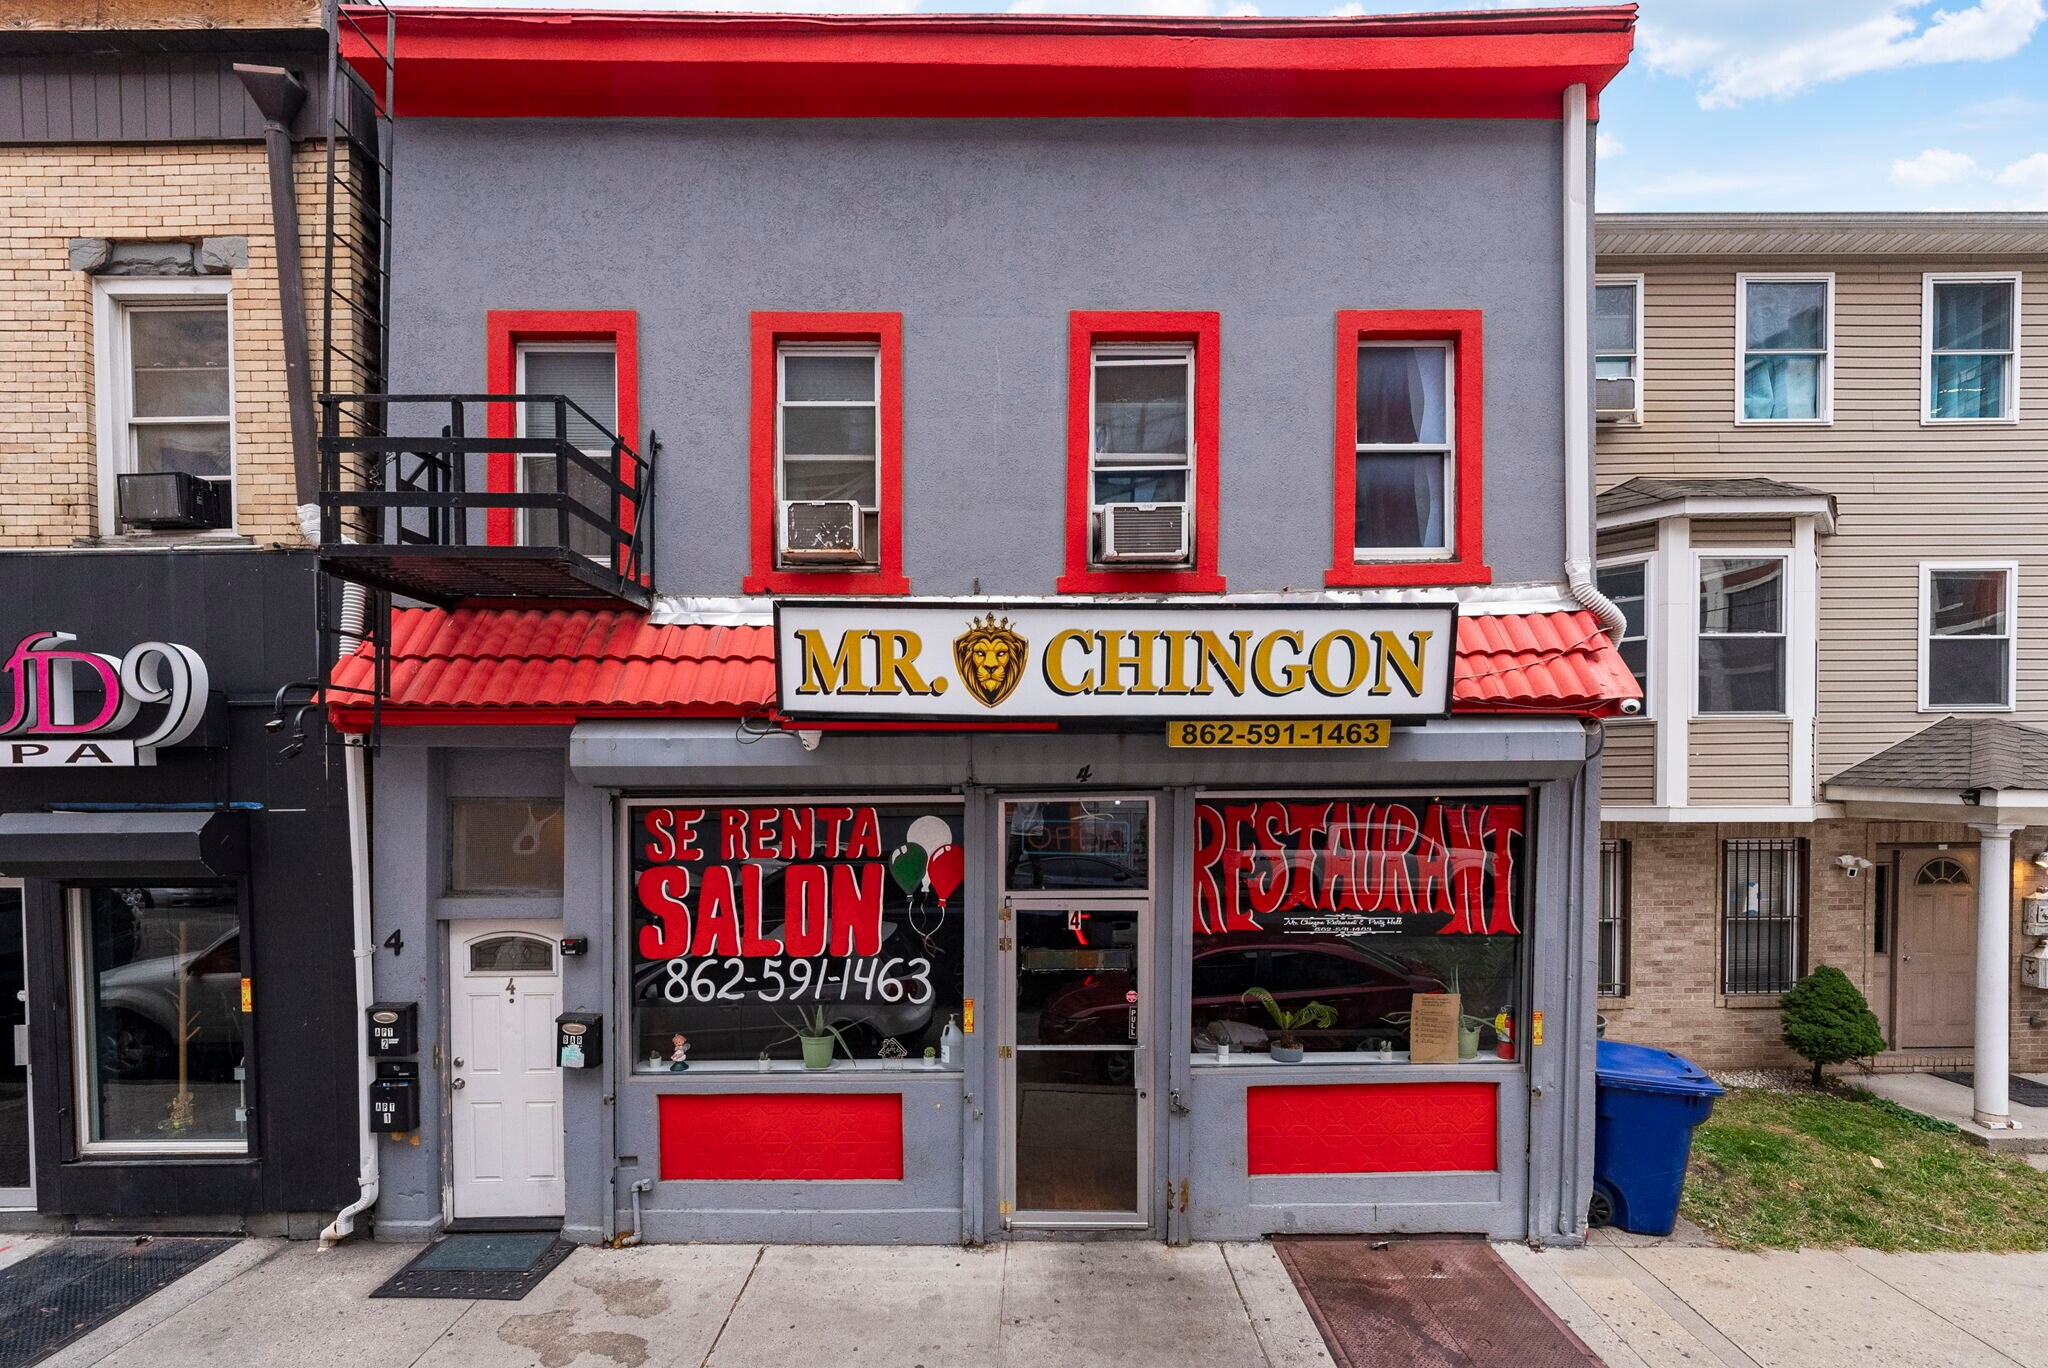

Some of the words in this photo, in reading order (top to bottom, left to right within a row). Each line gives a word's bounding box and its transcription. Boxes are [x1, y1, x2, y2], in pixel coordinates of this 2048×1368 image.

[795, 628, 948, 698] MR.
[1042, 628, 1433, 698] CHINGON
[1181, 722, 1380, 745] 862-591-1463
[1076, 764, 1092, 782] 4
[644, 808, 705, 863] SE
[720, 807, 882, 861] RENTA
[1028, 825, 1124, 849] OPEN
[638, 863, 885, 960] SALON
[1070, 911, 1081, 929] 4
[384, 929, 403, 955] 4
[506, 978, 516, 994] 4
[664, 958, 932, 1004] 862-591-1463
[375, 1028, 393, 1037] APT
[563, 1035, 583, 1044] BAR
[382, 1039, 389, 1049] 2
[376, 1103, 395, 1112] APT
